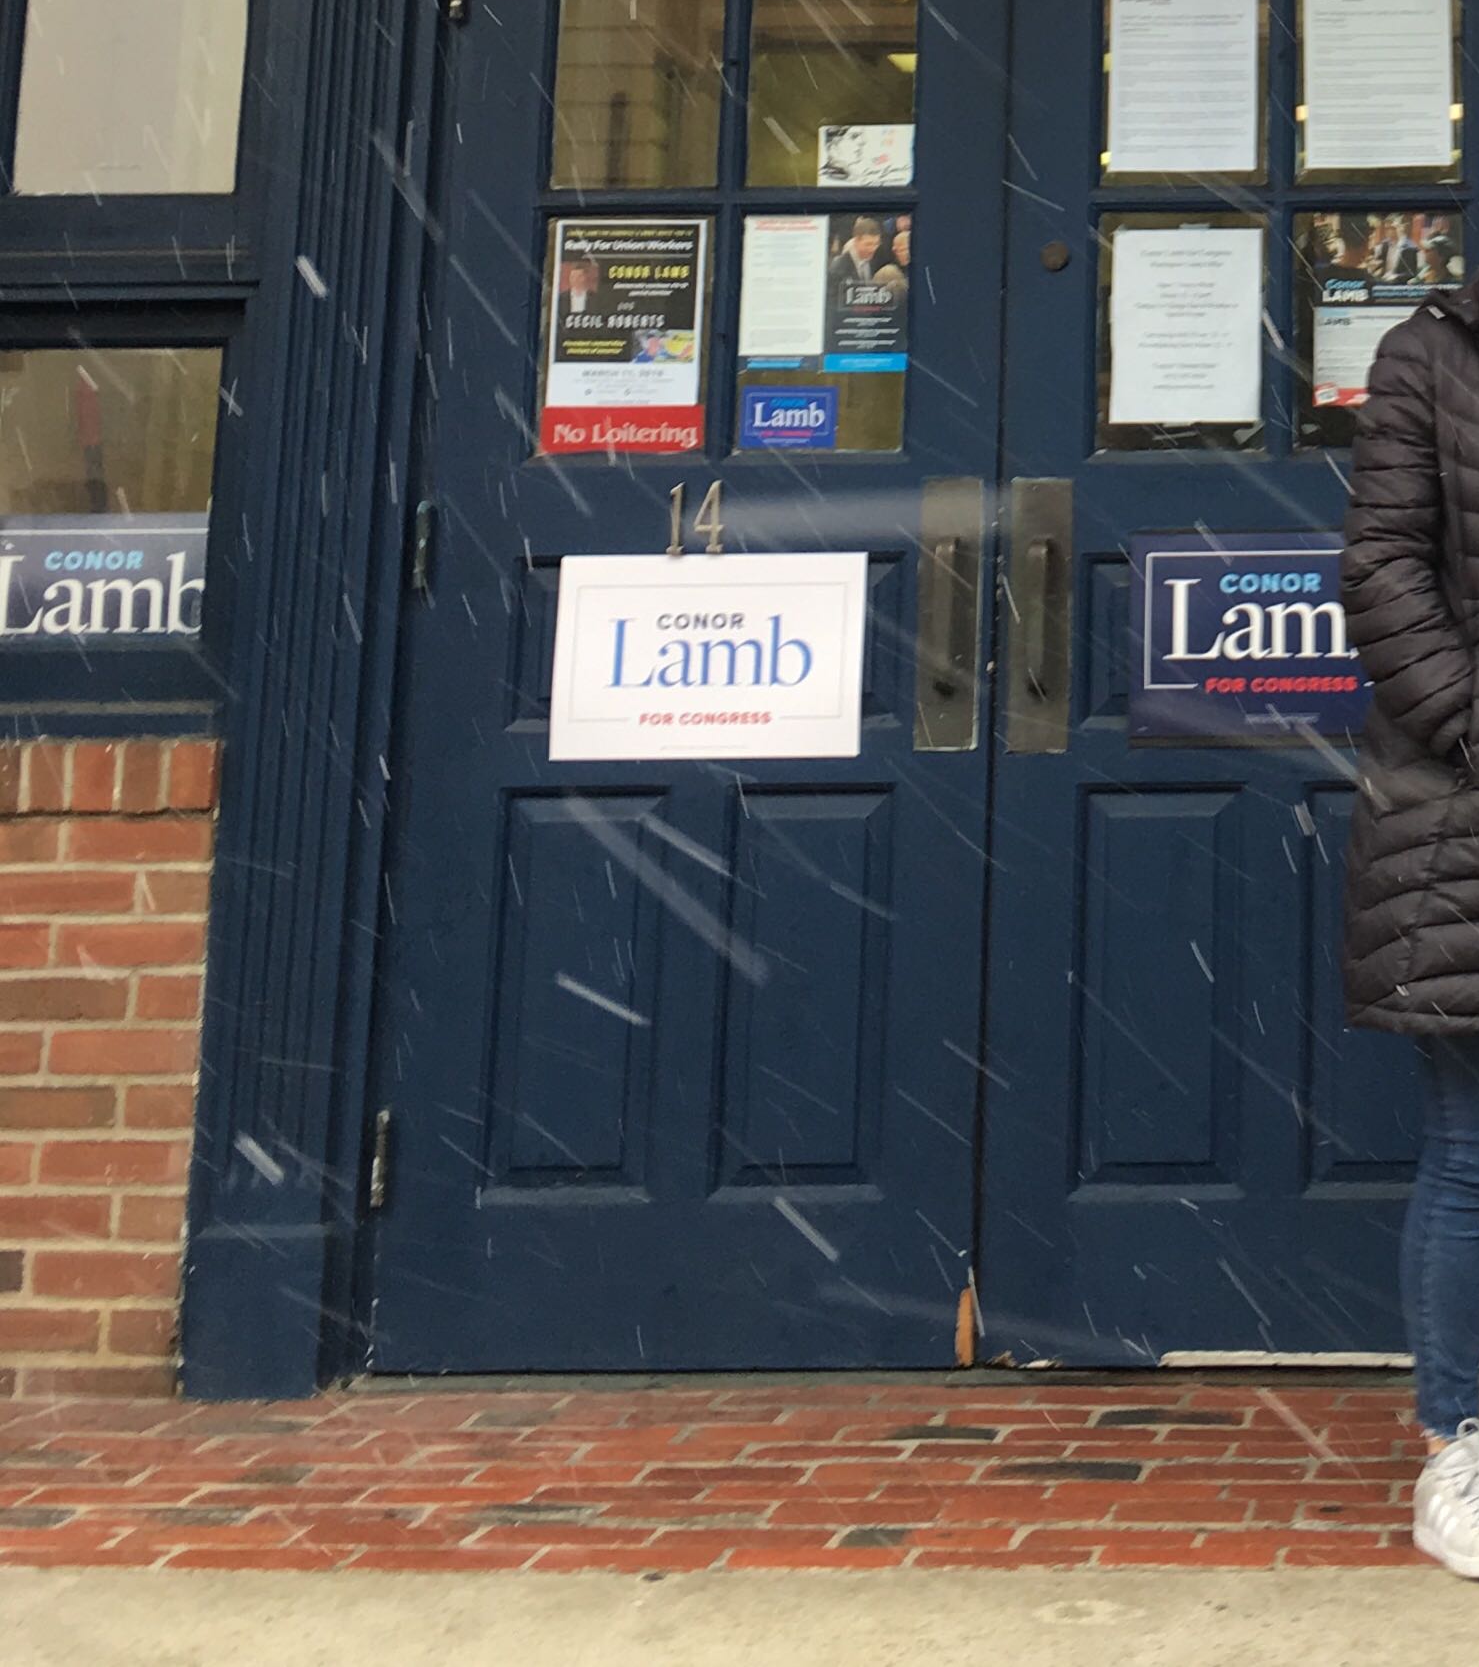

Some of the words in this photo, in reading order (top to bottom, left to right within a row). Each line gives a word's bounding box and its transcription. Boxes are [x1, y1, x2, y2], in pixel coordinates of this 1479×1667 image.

[564, 239, 592, 252] Rally
[594, 239, 612, 250] For
[613, 239, 645, 250] Union
[647, 239, 693, 250] Workers
[846, 286, 893, 305] Lamb
[1322, 289, 1369, 303] LAMB
[565, 314, 603, 328] CECIL
[607, 314, 665, 328] ROBERTS
[753, 401, 826, 428] Lamb
[553, 423, 586, 444] No
[591, 421, 698, 448] Loitering
[666, 480, 724, 556] 14
[44, 550, 144, 570] CONOR
[0, 551, 206, 635] Lamb
[1219, 573, 1322, 594] CONOR
[657, 613, 745, 630] CONOR
[1162, 578, 1360, 660] Lam
[605, 614, 813, 690] Lamb
[1205, 677, 1246, 694] FOR
[1251, 676, 1358, 694] CONGRESS
[638, 713, 674, 726] FOR
[679, 711, 772, 726] CONGRESS
